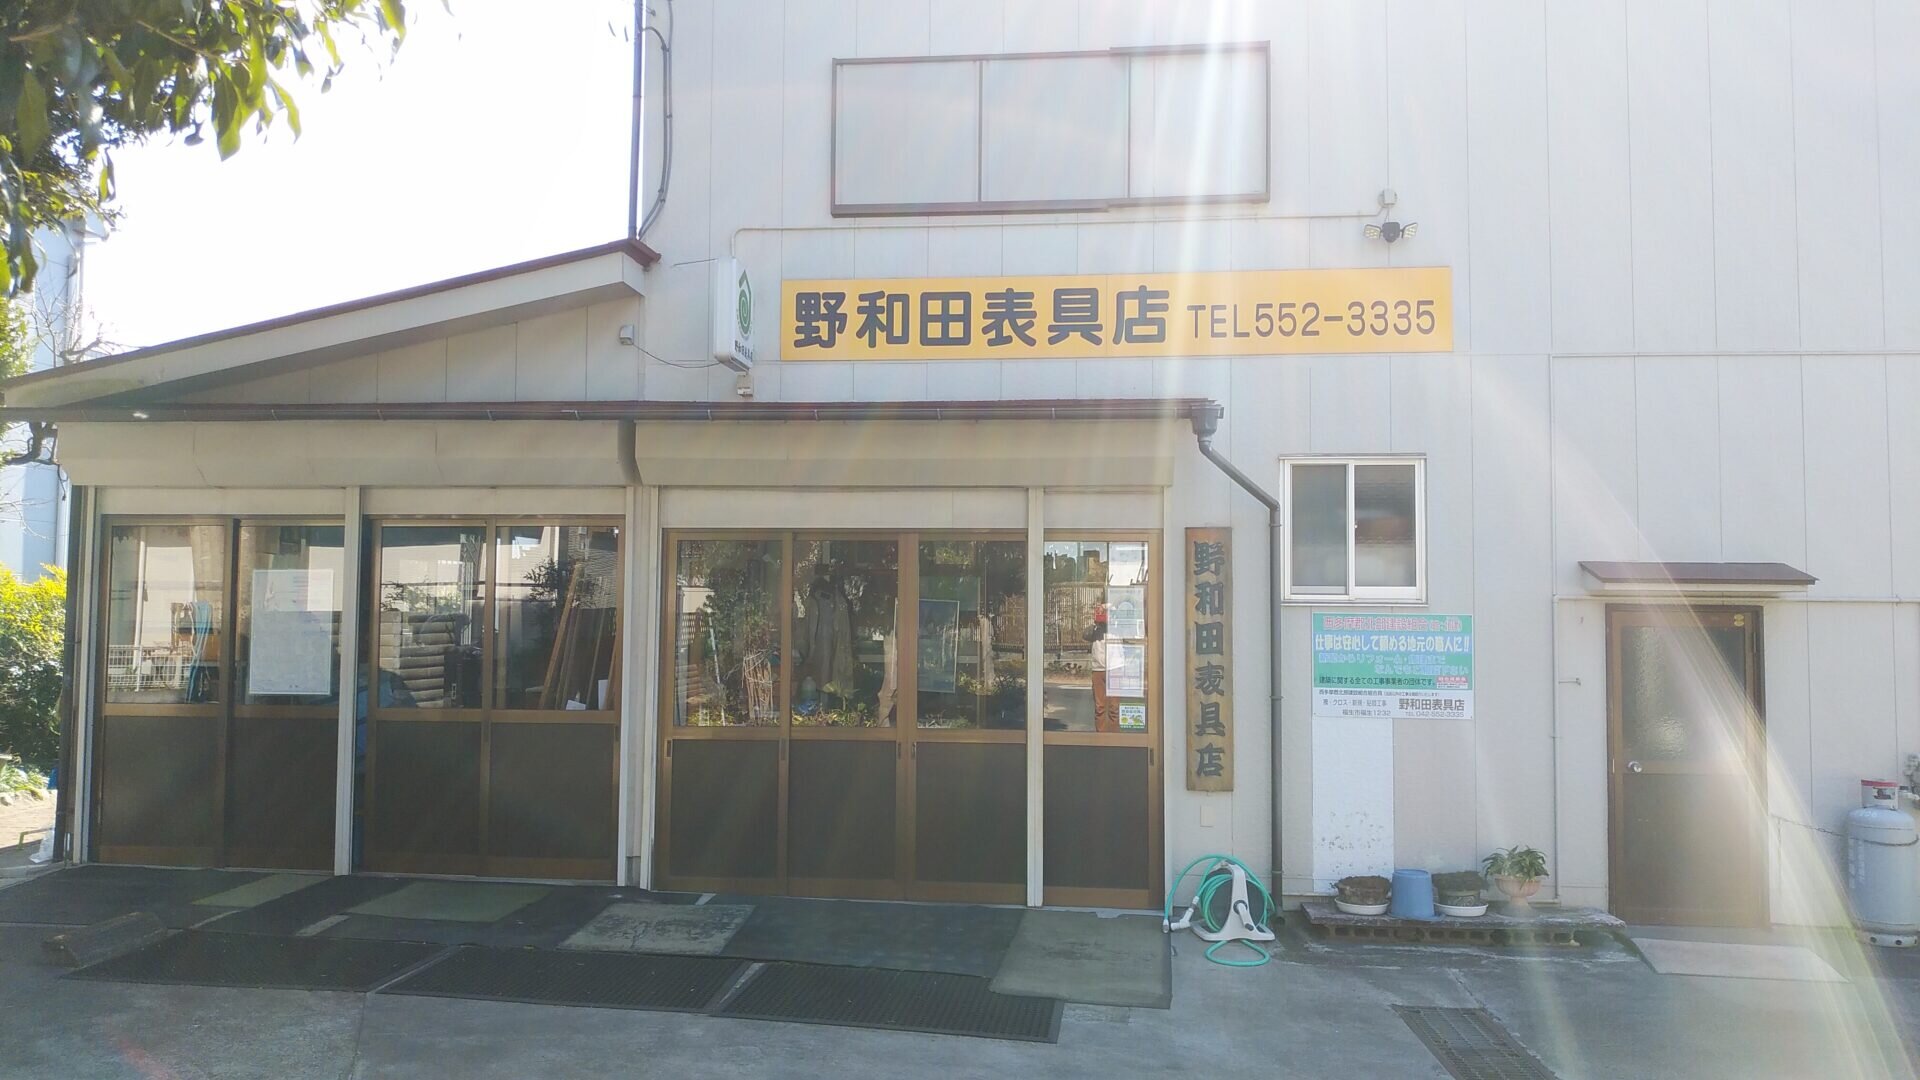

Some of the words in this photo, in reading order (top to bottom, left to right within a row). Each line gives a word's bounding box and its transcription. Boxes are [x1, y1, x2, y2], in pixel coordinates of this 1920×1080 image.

[793, 284, 1169, 350] 野和田表具店
[1193, 540, 1226, 777] 野和田表具店
[1398, 698, 1465, 711] 野和田表具店
